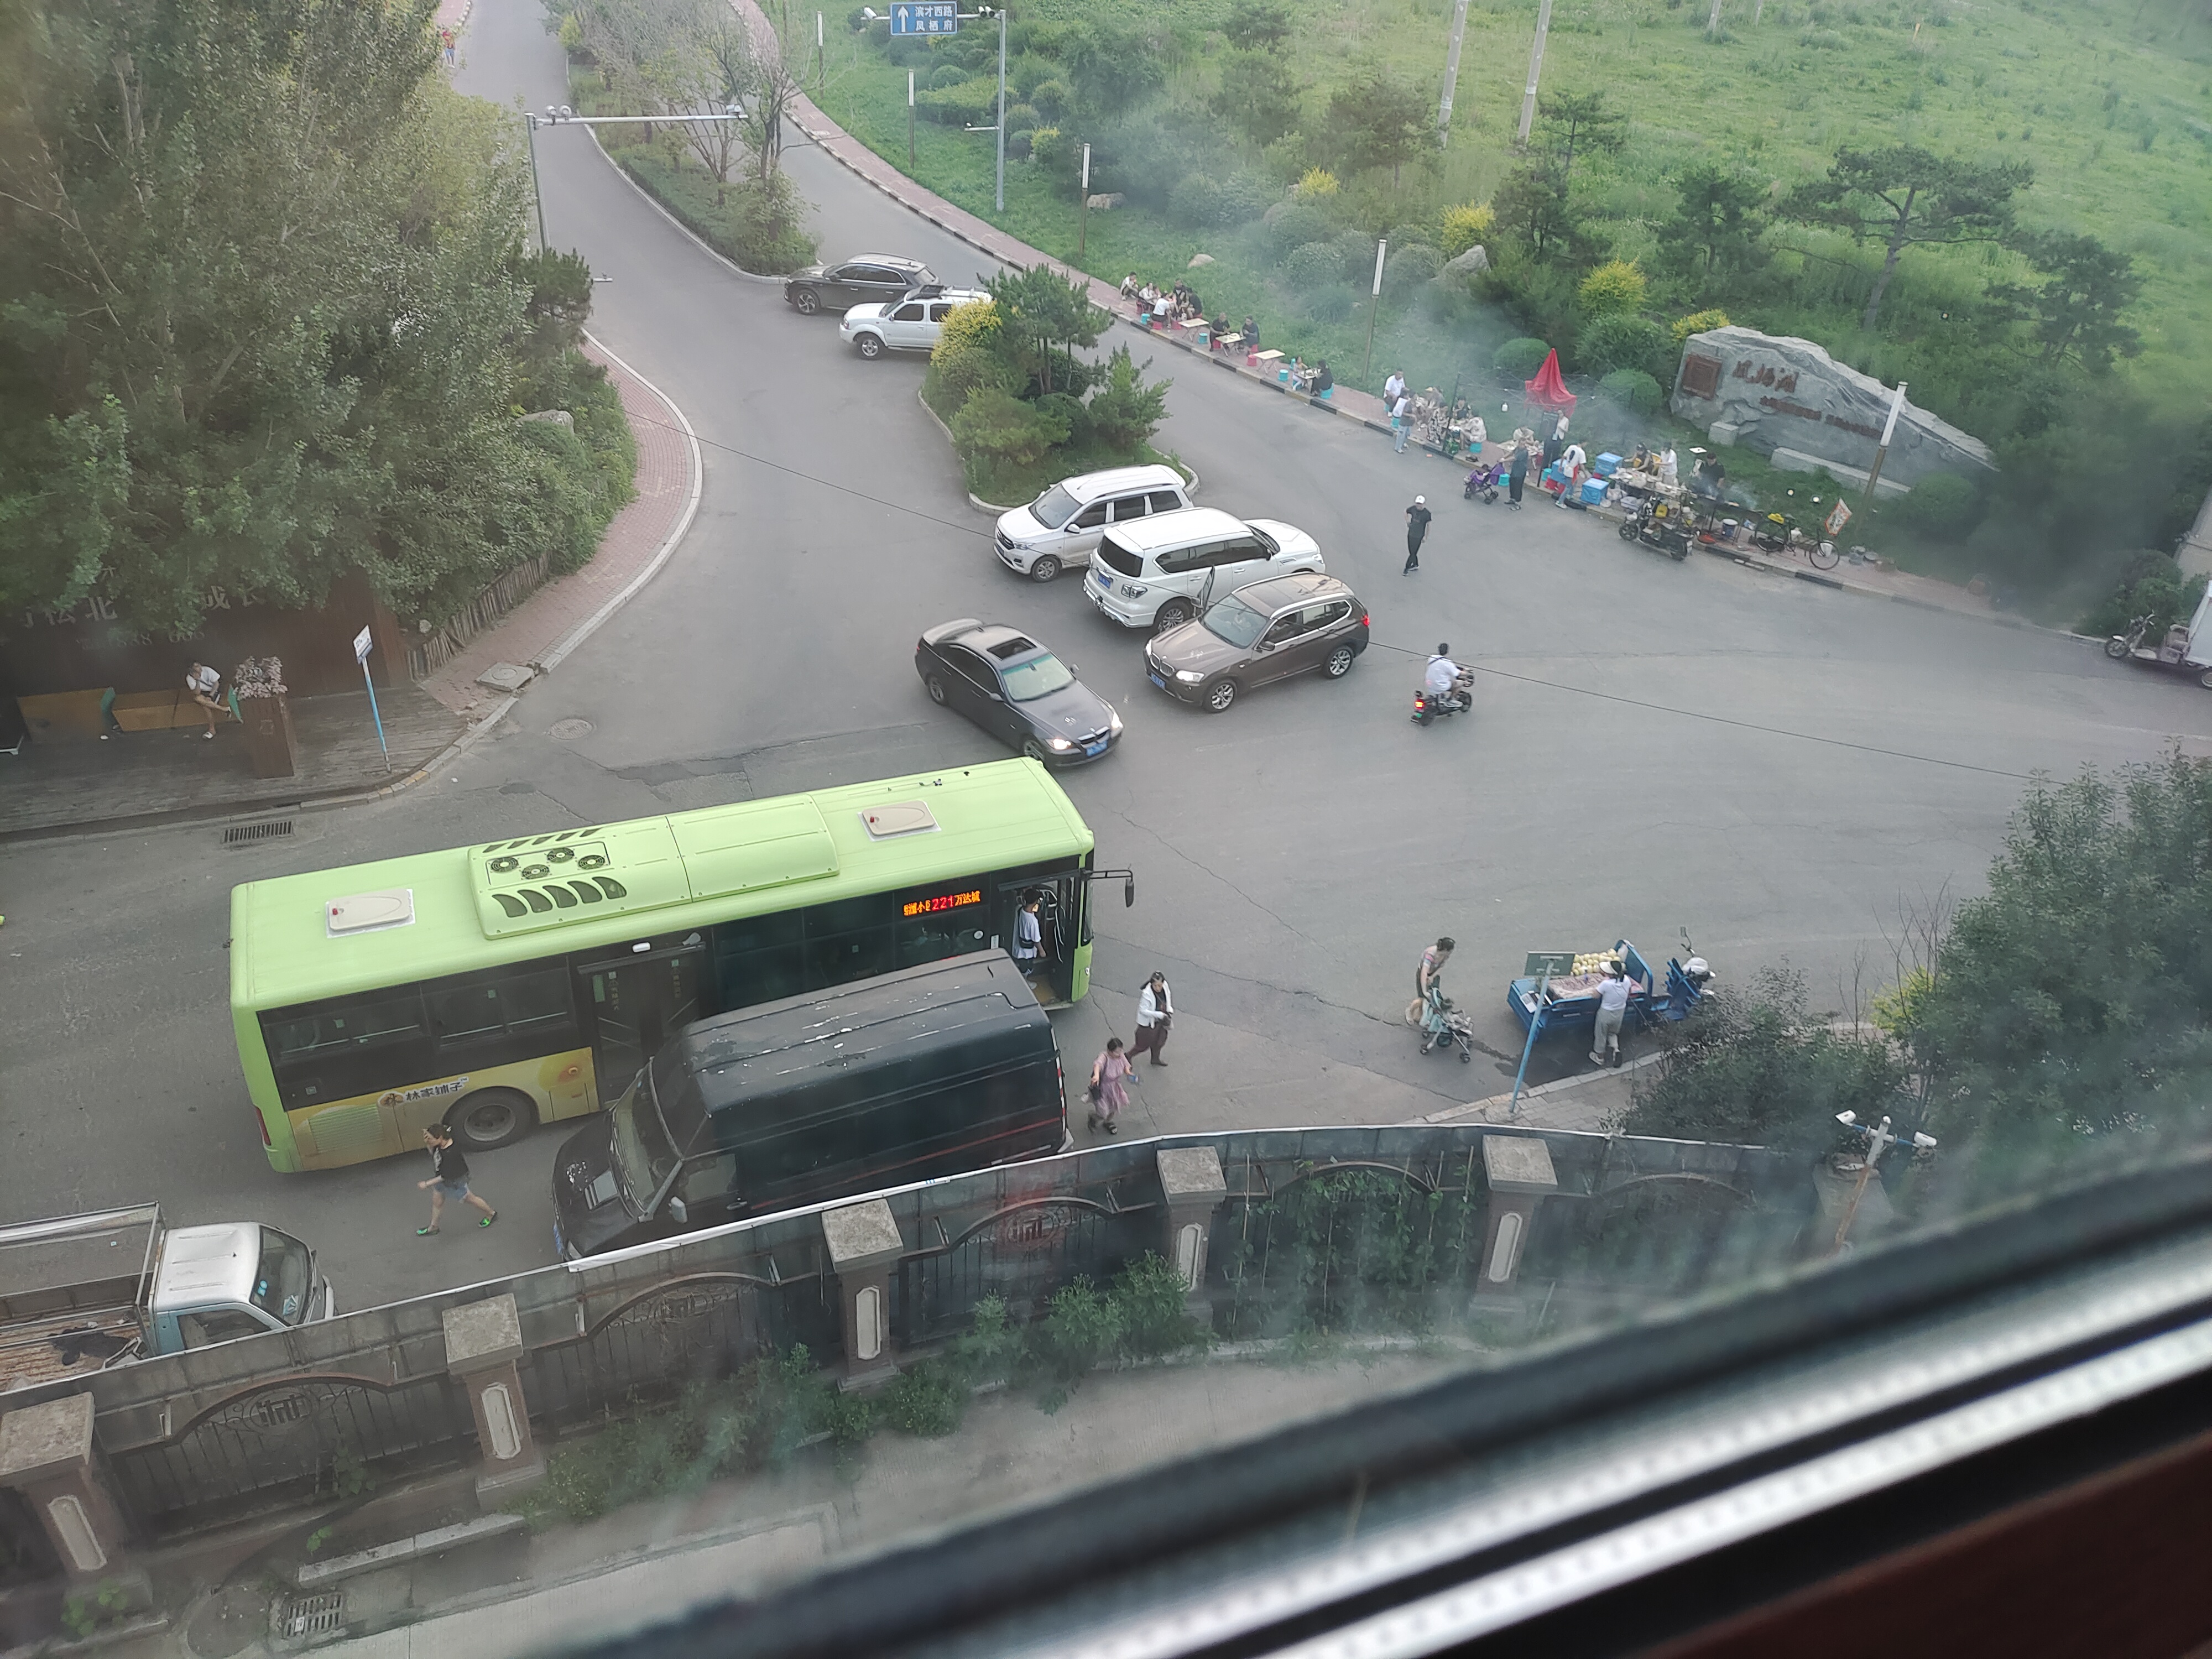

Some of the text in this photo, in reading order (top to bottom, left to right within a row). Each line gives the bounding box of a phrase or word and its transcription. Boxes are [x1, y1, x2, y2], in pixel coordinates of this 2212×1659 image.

[932, 895, 953, 911] 221
[405, 1082, 462, 1102] 林家铺子
